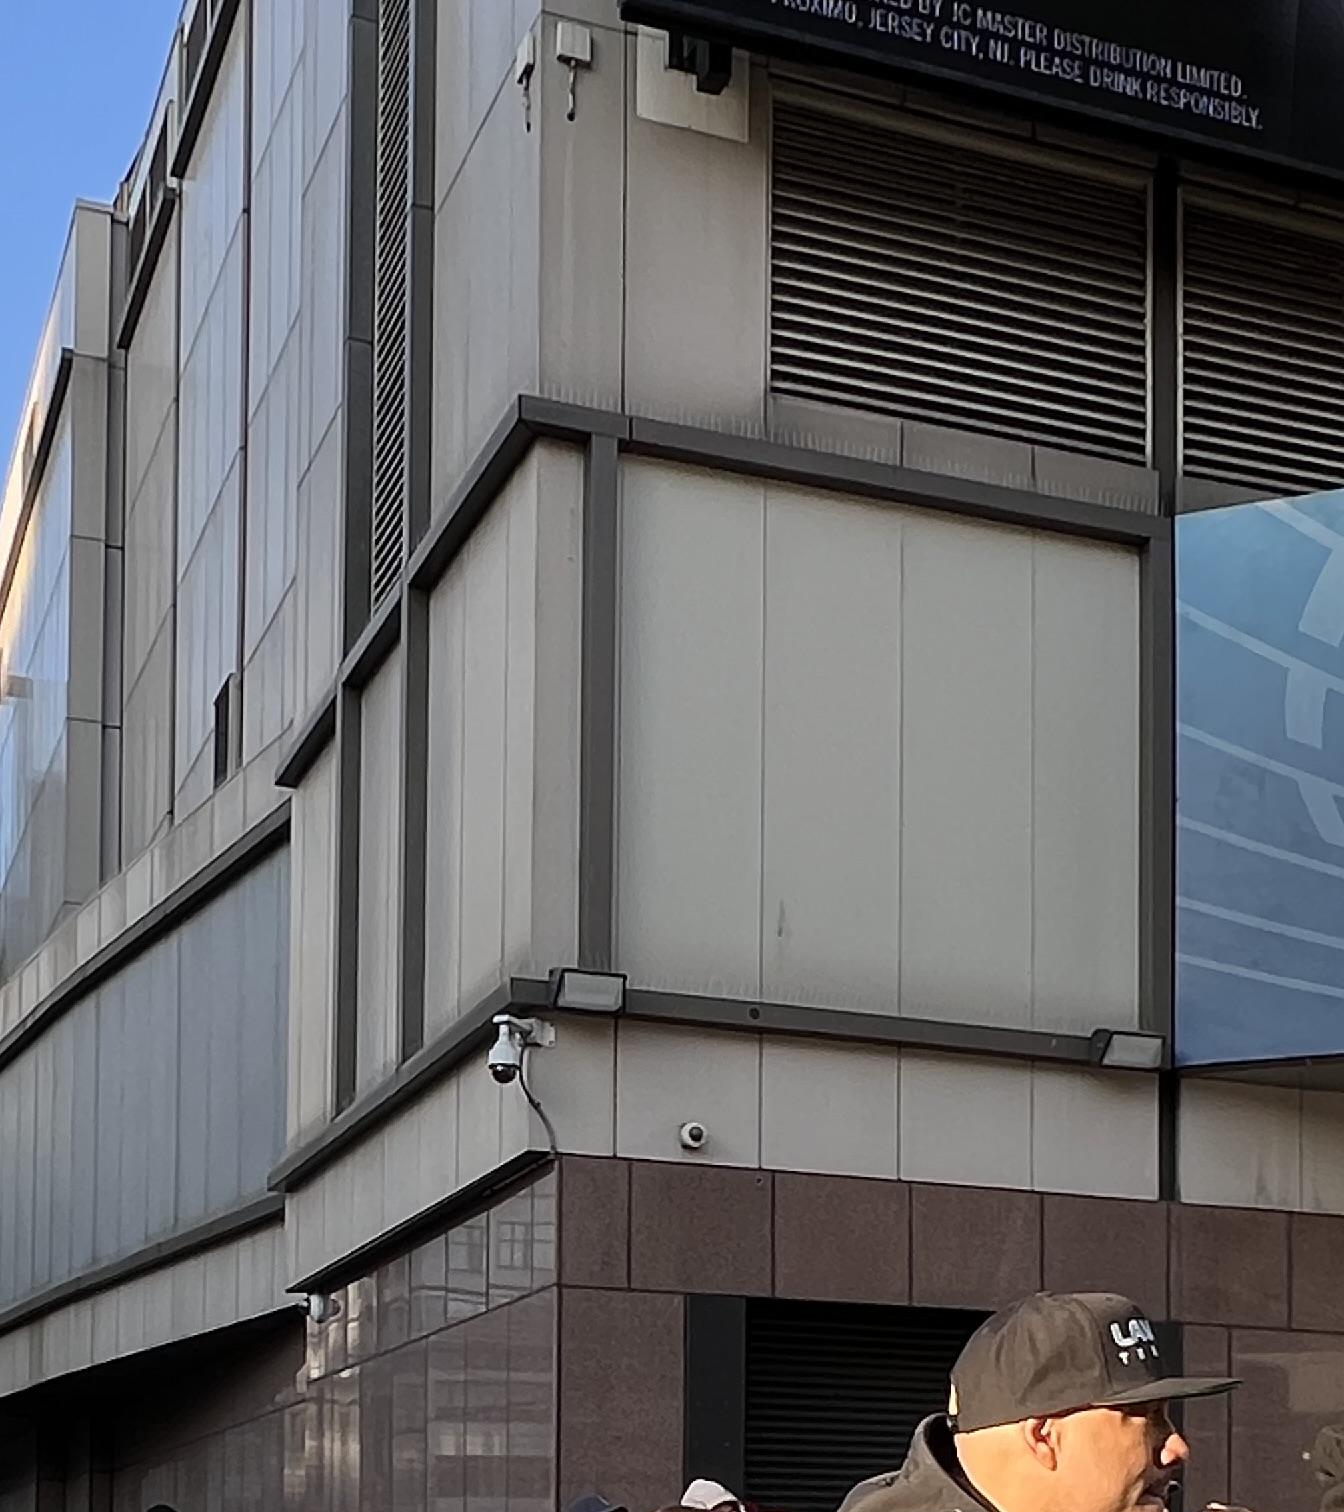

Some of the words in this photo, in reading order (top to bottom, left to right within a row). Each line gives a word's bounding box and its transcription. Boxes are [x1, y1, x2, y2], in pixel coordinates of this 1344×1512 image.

[868, 7, 935, 43] JERSEY
[1019, 46, 1084, 84] PLEASE
[1089, 64, 1144, 100] DRINK
[1146, 80, 1264, 129] RESPONSIBLY.
[976, 7, 1048, 47] MASTER
[1054, 28, 1172, 78] DISTRIBUTION
